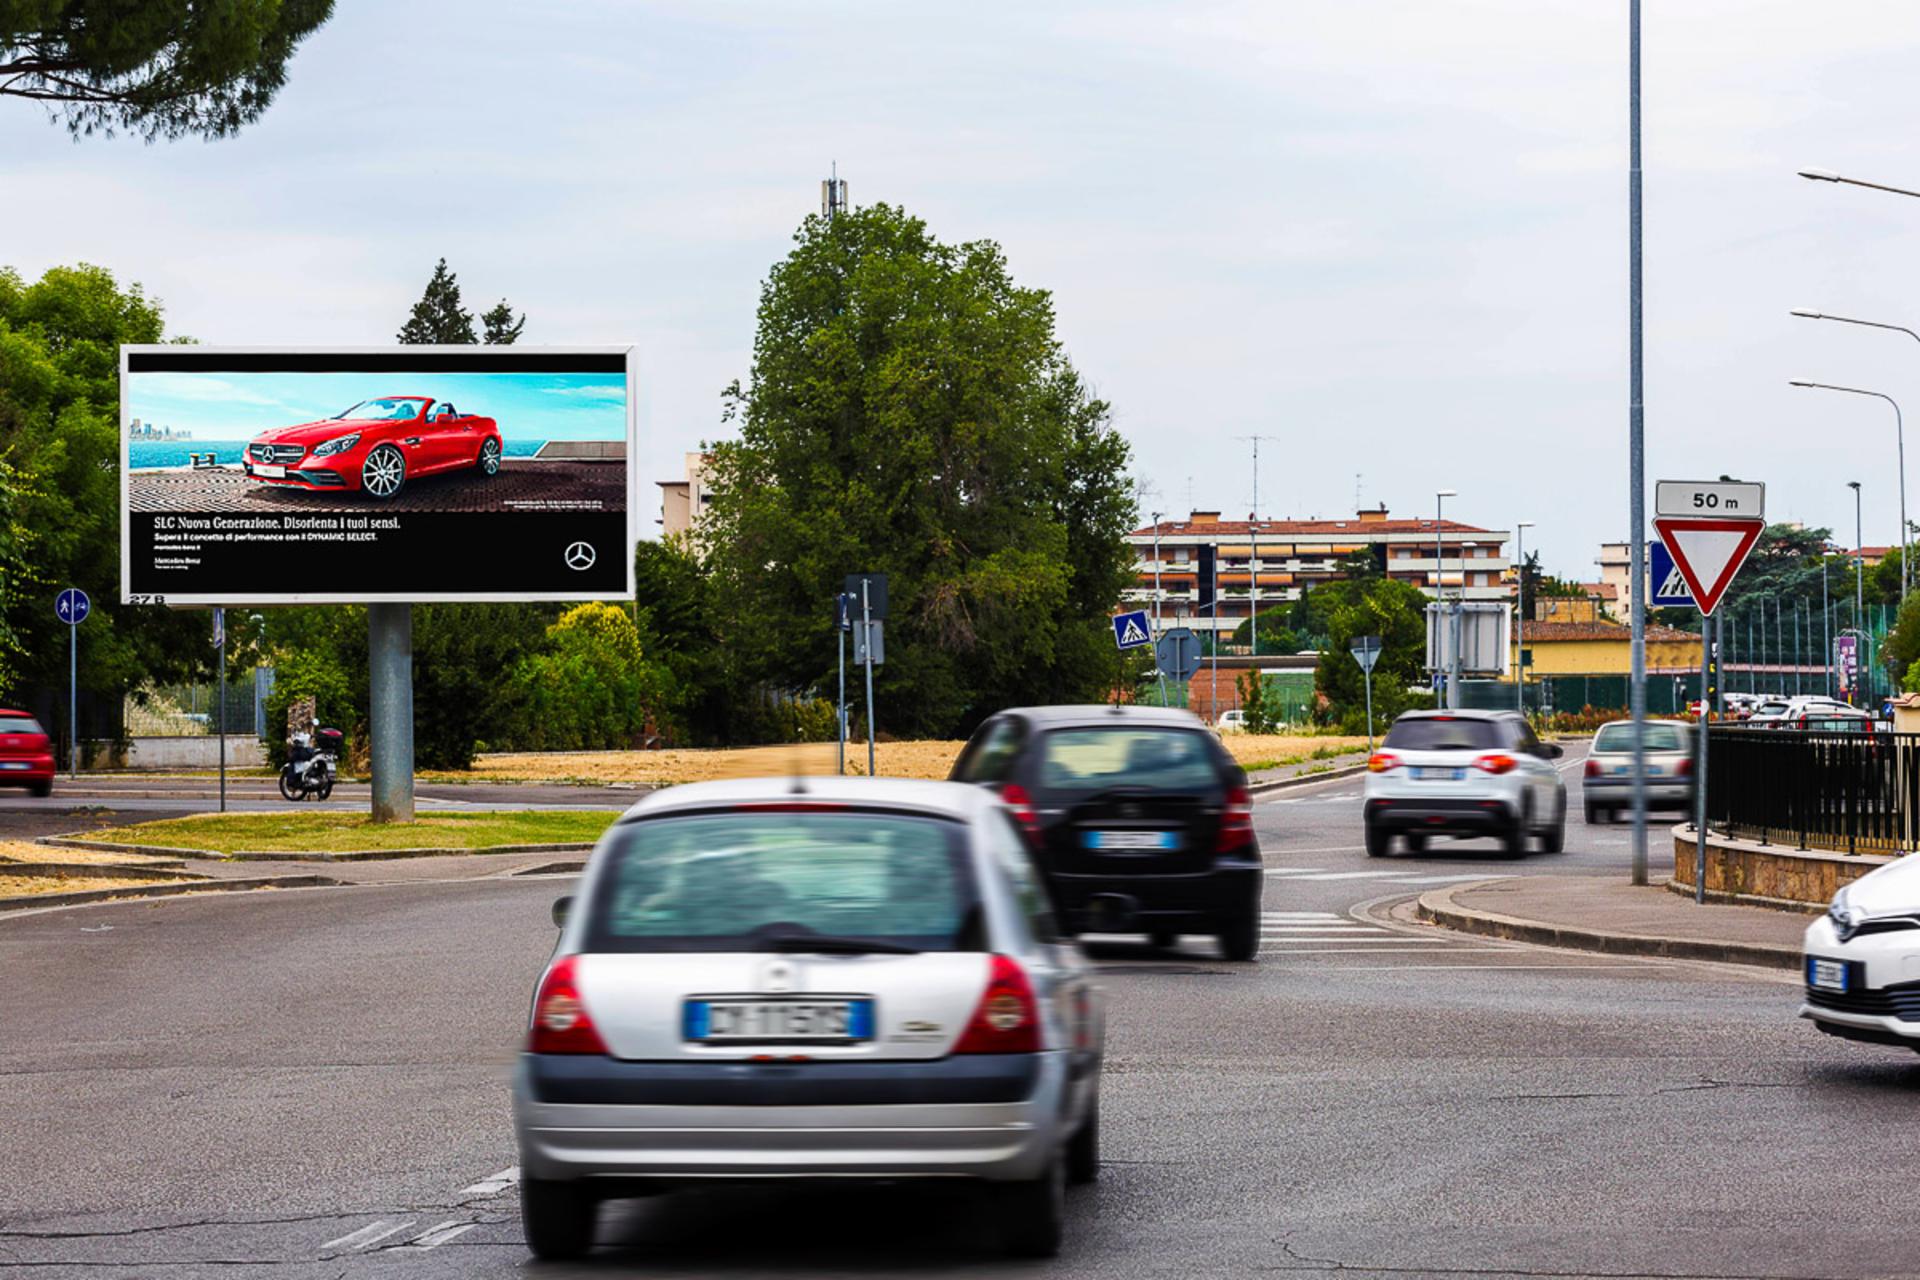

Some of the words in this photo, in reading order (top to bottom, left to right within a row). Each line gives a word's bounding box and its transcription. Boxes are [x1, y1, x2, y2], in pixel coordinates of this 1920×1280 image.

[1693, 493, 1719, 508] 50
[1725, 499, 1738, 509] m
[153, 516, 176, 529] SLC
[177, 516, 211, 529] Nuova
[212, 516, 282, 529] Generazione.
[284, 516, 338, 529] Disorienta
[346, 516, 368, 529] tuoi
[370, 516, 401, 529] sensi.
[234, 532, 283, 542] performance
